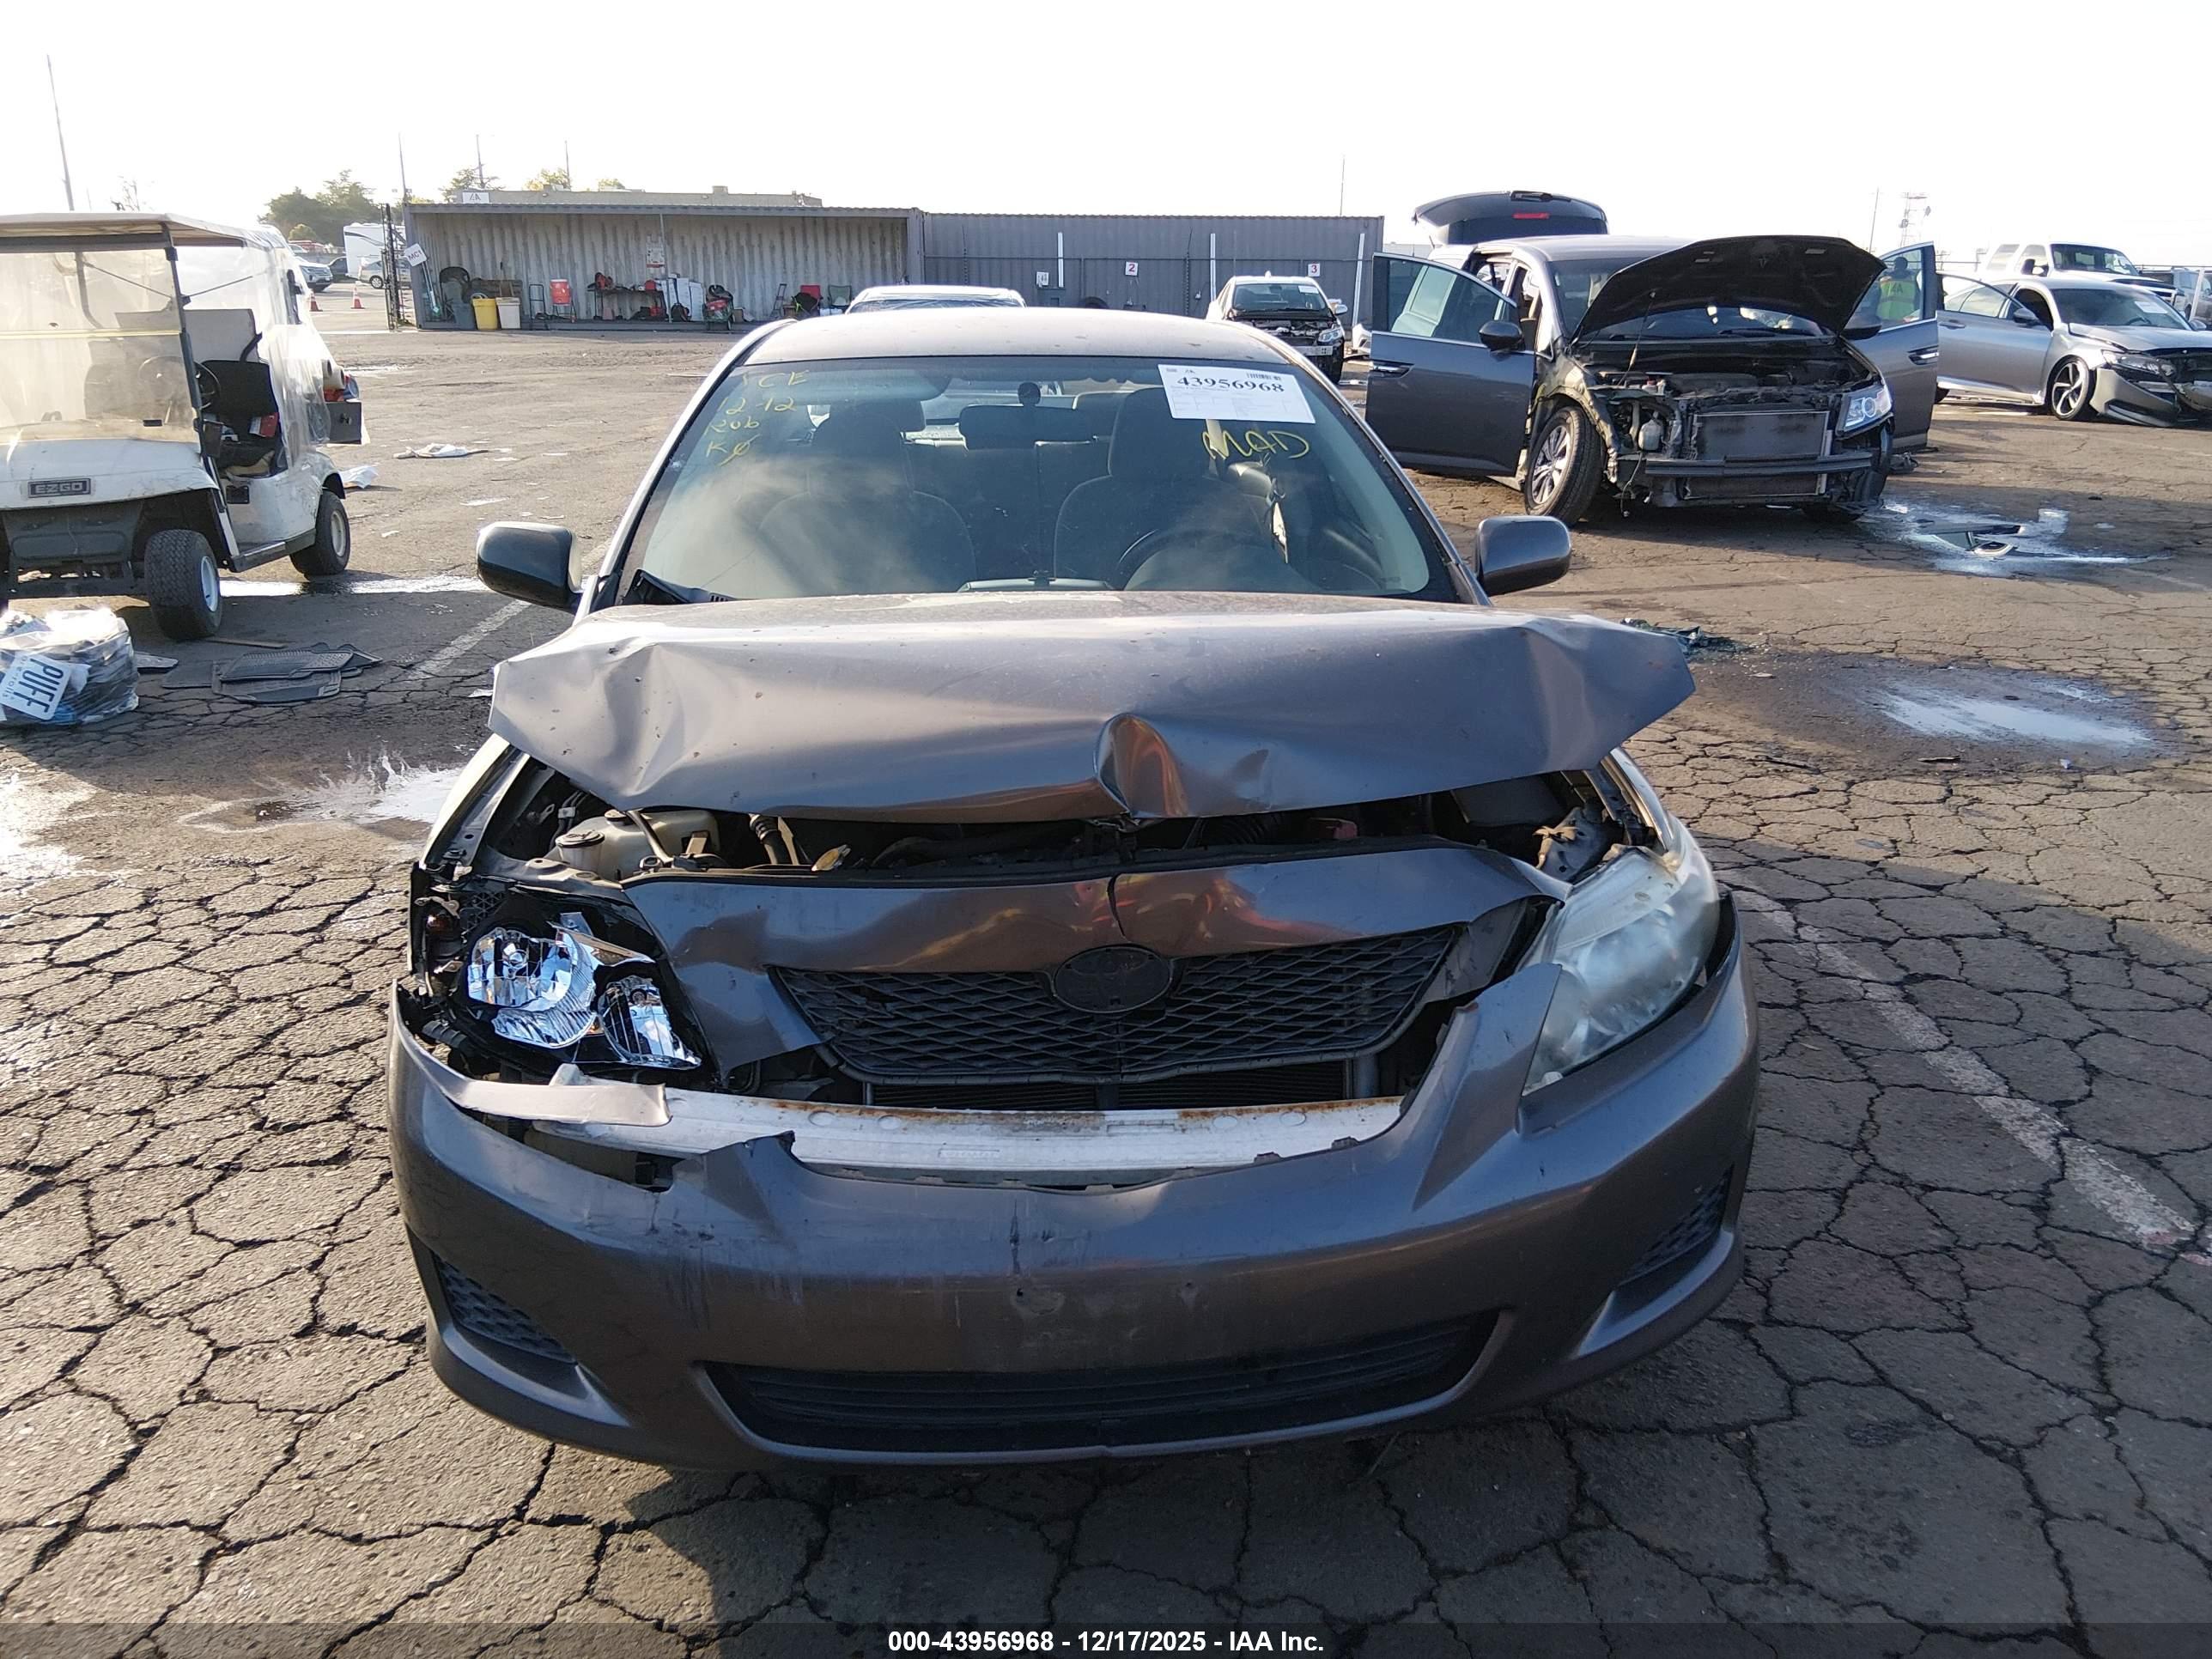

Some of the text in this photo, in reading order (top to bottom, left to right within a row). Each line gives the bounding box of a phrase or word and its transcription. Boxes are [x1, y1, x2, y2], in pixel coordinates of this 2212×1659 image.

[1311, 264, 1318, 273] 3
[1177, 376, 1285, 392] 43956968
[13, 658, 64, 713] PUFF
